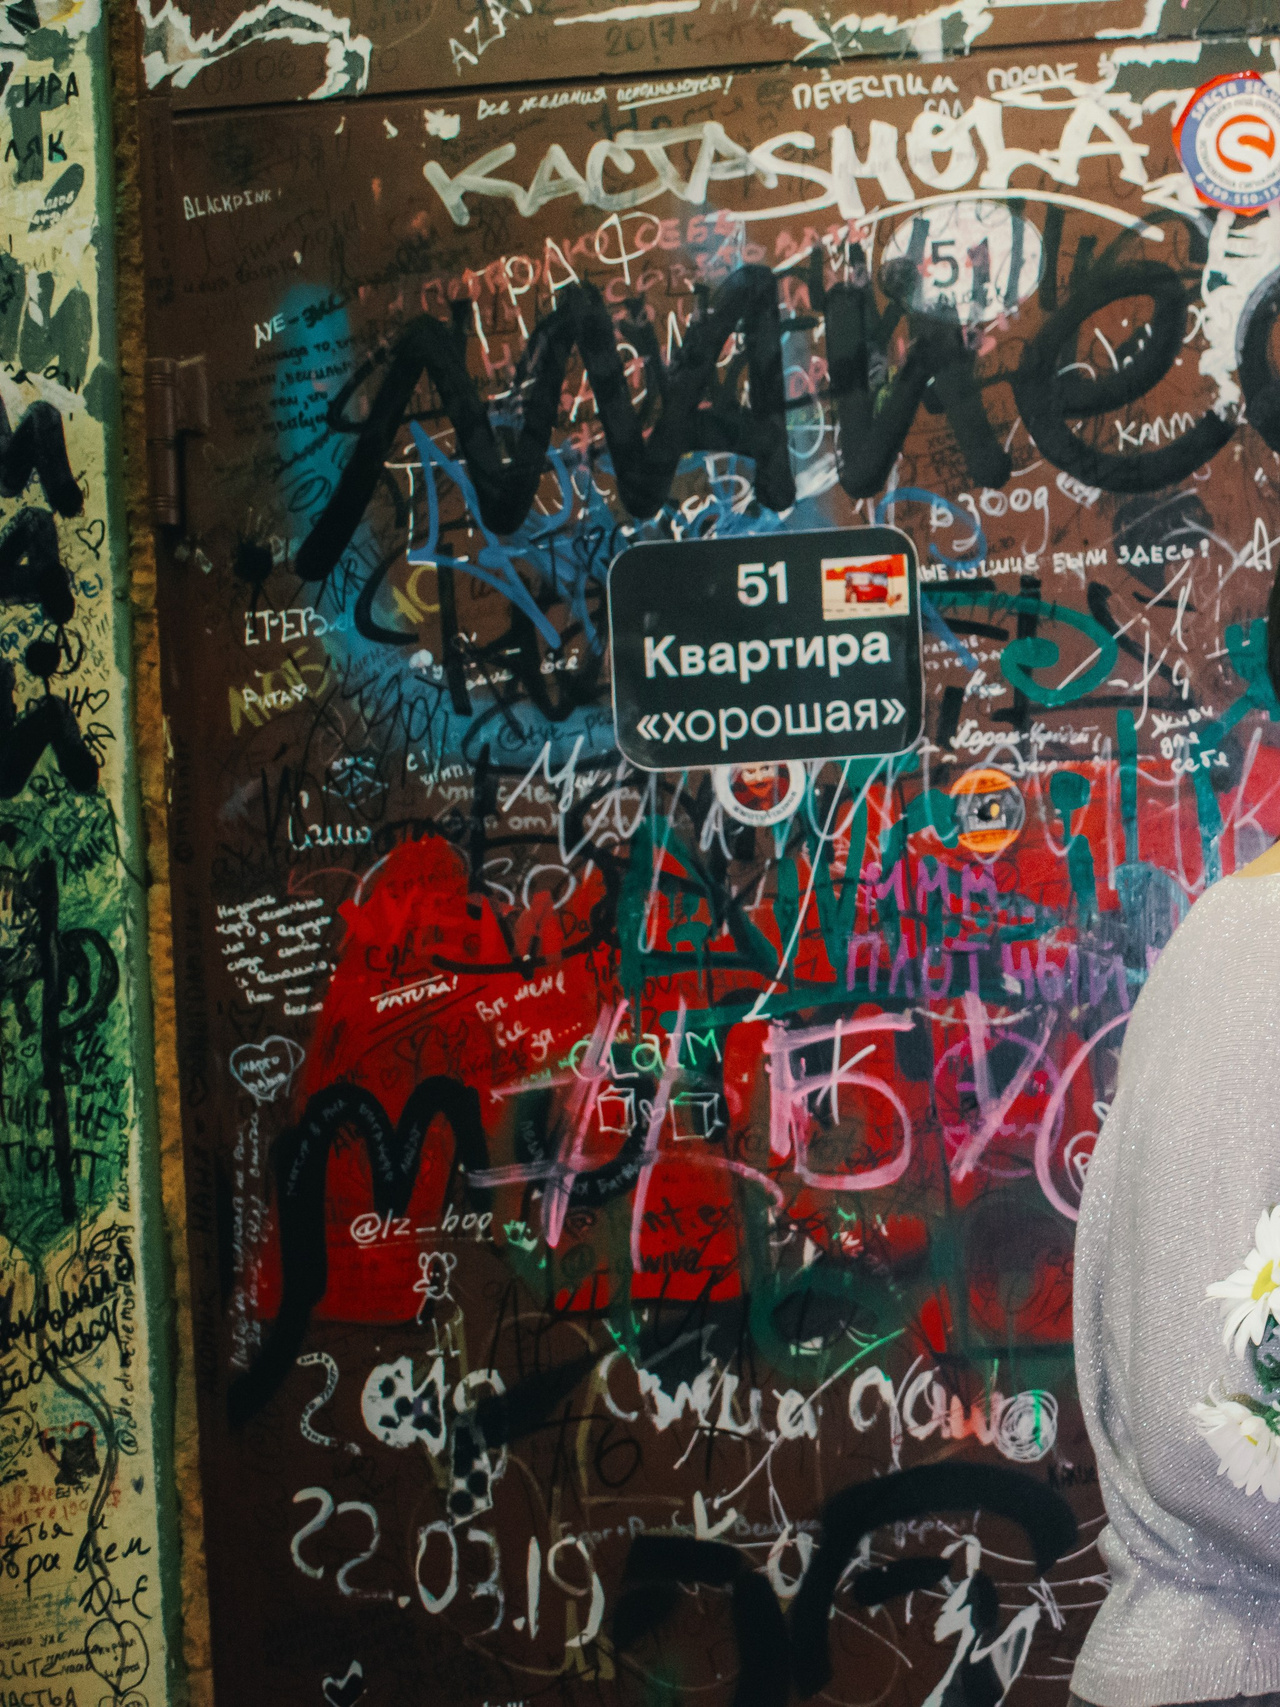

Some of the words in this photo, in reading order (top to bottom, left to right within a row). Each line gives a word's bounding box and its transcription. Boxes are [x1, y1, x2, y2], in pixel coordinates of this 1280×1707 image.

[25, 72, 78, 107] ИРА
[736, 560, 788, 607] 51
[1052, 548, 1108, 575] БЫЛИ
[644, 630, 891, 684] Квартира
[636, 698, 907, 751] «хорошая»
